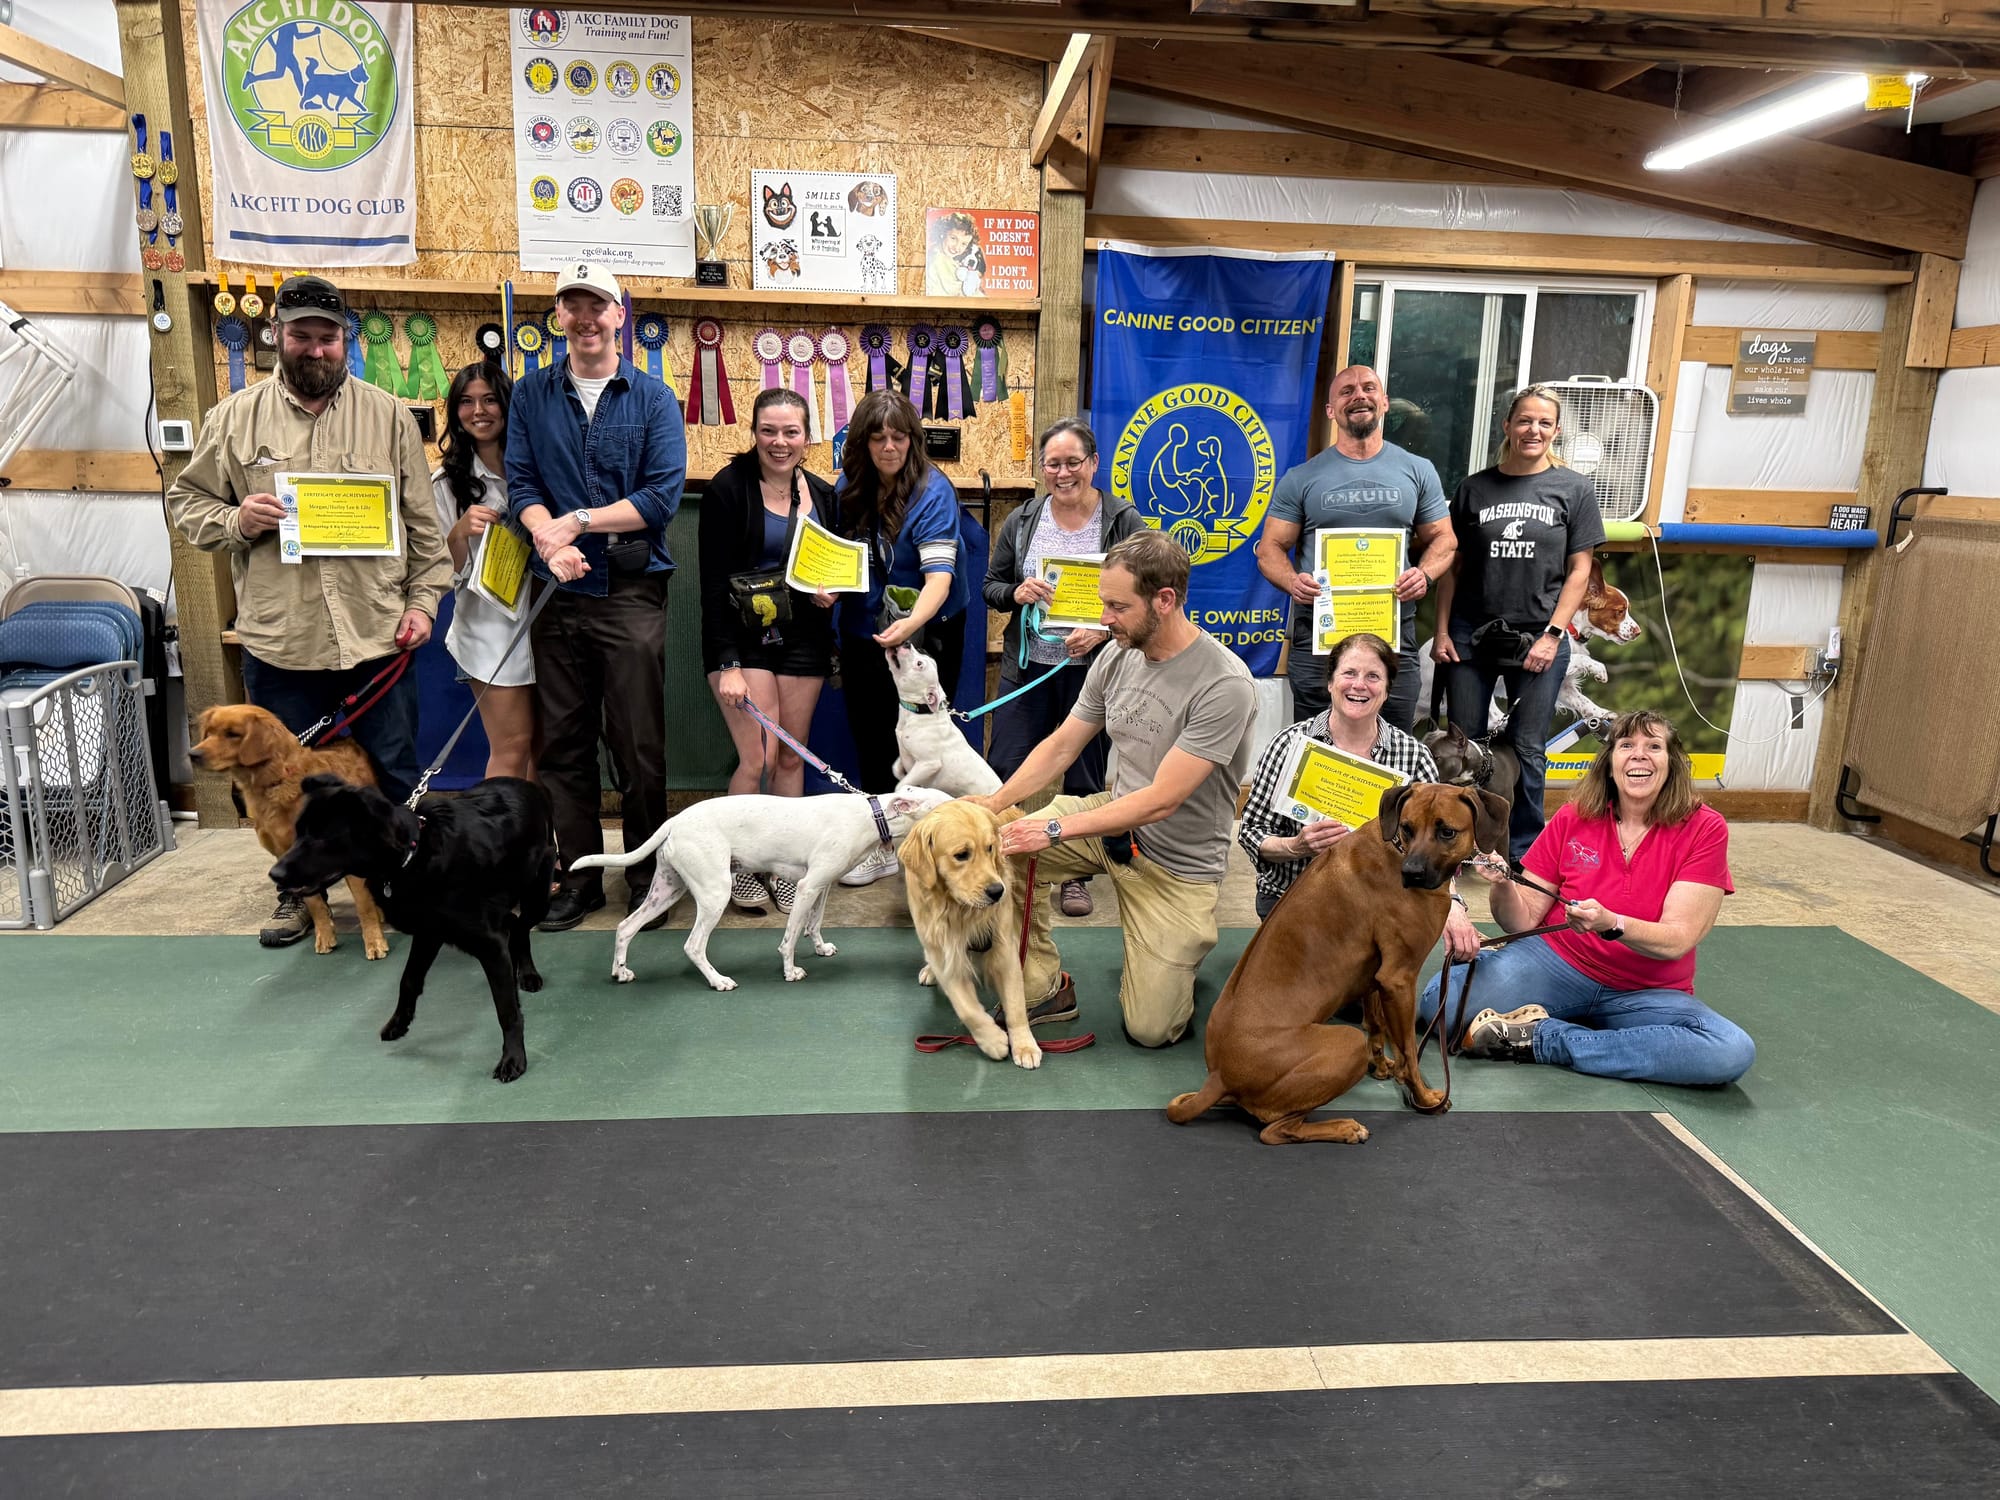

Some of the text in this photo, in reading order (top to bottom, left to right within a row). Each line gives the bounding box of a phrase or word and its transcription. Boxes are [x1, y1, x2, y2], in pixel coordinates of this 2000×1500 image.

[575, 13, 679, 30] AKC FAMILY DOG
[226, 0, 385, 65] AKC FIT DOG
[585, 26, 670, 40] Training and Fun!
[301, 124, 327, 151] AKC
[577, 186, 592, 201] ATT
[805, 191, 841, 200] SMILES
[230, 191, 406, 216] AKC FIT DOG CLUB
[984, 218, 1035, 230] IF MY DOG
[989, 232, 1030, 243] DOESN'T
[582, 247, 633, 259] cgc@akc.org
[985, 245, 1010, 256] LIKE
[992, 266, 1028, 277] I DON'T
[985, 279, 1010, 289] LIKE
[1104, 309, 1174, 331] CANINE
[1178, 316, 1235, 333] GOOD
[1748, 334, 1792, 365] dogs
[1773, 376, 1790, 386] they
[1747, 396, 1792, 405] lives whole
[1114, 403, 1159, 489] CANINE
[1163, 387, 1229, 408] GOOD
[1233, 404, 1272, 494] CITIZEN
[1348, 489, 1398, 503] KUIU
[1479, 502, 1556, 526] WASHINGTON
[1830, 518, 1865, 530] HEART
[1490, 541, 1536, 558] STATE
[1204, 608, 1284, 625] OWNERS,
[1237, 629, 1285, 646] DOGS
